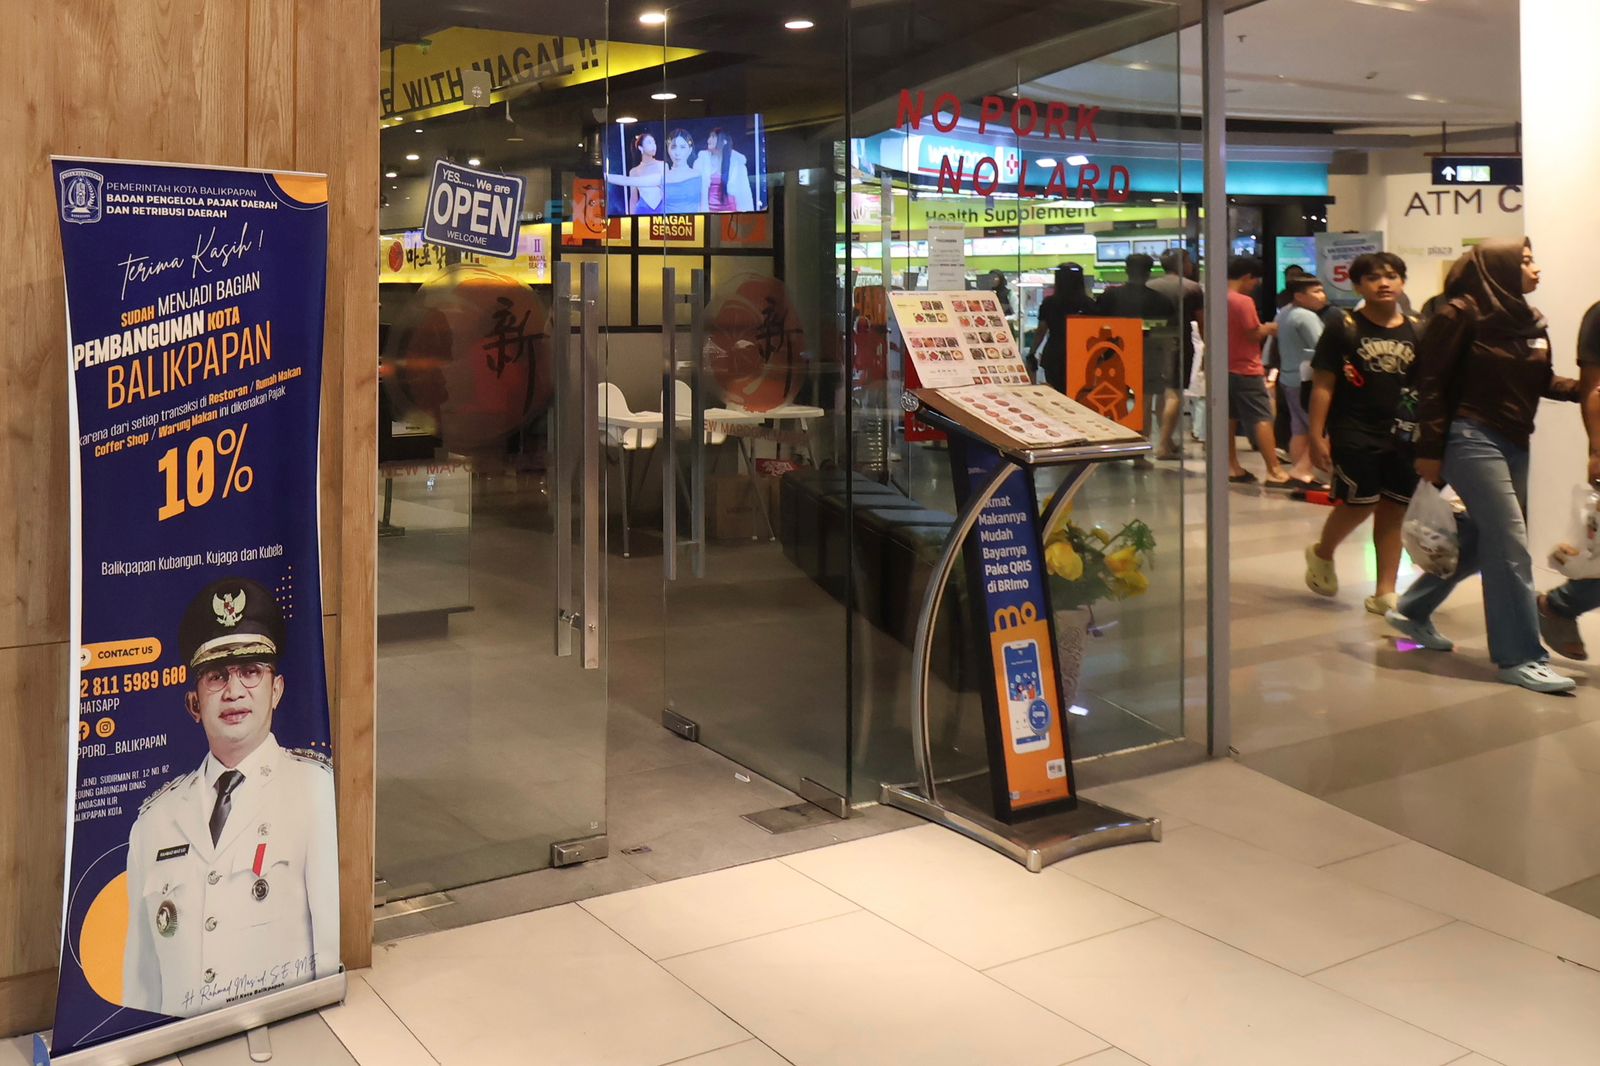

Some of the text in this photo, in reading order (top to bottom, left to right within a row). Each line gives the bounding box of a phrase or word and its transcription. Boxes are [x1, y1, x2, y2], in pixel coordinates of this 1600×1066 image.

[402, 67, 464, 108] WITH
[897, 89, 1100, 142] NO PORK
[476, 178, 492, 191] We
[494, 184, 511, 194] are
[937, 155, 1131, 201] NO LARD
[106, 182, 257, 197] PEMERINTAH KOTA BALIKPAPAN
[106, 194, 278, 210] BADAN PENGELOLA PAJAK DAERAH
[433, 182, 514, 238] OPEN
[1404, 188, 1482, 216] ATM
[106, 205, 228, 219] DAN RETRIBUSI DAERAH
[652, 215, 693, 226] MAGAL
[925, 204, 1098, 224] Health Supplement
[447, 230, 487, 245] WELCOME
[652, 225, 692, 237] SEASON
[118, 254, 185, 300] Terima
[192, 222, 252, 278] Kasih
[121, 271, 261, 328] SUDAH MENJADI BAGIAN
[73, 306, 241, 372] PEMBANGUNAN KOTA
[107, 320, 272, 409] BALIKPAPAN
[111, 420, 130, 437] dari
[131, 412, 159, 430] setiap
[161, 398, 199, 421] transaksi
[200, 394, 207, 408] di
[208, 385, 249, 405] Restoran
[255, 374, 278, 391] Rumah
[277, 367, 302, 383] Makan
[95, 438, 125, 458] Coffer
[126, 432, 150, 448] Shop
[158, 419, 191, 438] Warung
[191, 410, 218, 426] Makan
[219, 403, 229, 418] ini
[230, 393, 268, 415] dikenakan
[268, 384, 286, 401] Pajak
[158, 423, 254, 521] 10%
[984, 496, 1011, 508] kmat
[978, 512, 1027, 525] Makannya
[981, 528, 1014, 542] Mudah
[101, 560, 156, 576] Balikpapan
[206, 548, 238, 567] Kujaga
[240, 547, 258, 561] dan
[259, 543, 283, 559] Kubela
[982, 545, 1028, 560] Bayarnya
[985, 559, 1032, 576] Pake QRIS
[987, 580, 996, 593] di
[97, 646, 153, 660] CONTACT US
[93, 675, 120, 696] 811
[123, 670, 159, 693] 5989
[162, 665, 187, 687] 600
[100, 772, 131, 785] SUDIRMAN
[142, 768, 150, 778] 12
[95, 784, 129, 797] GABUNGAN
[129, 780, 147, 791] DINAS
[107, 807, 123, 817] KOTA
[226, 982, 285, 1003] Wali Kota Balikpapan
